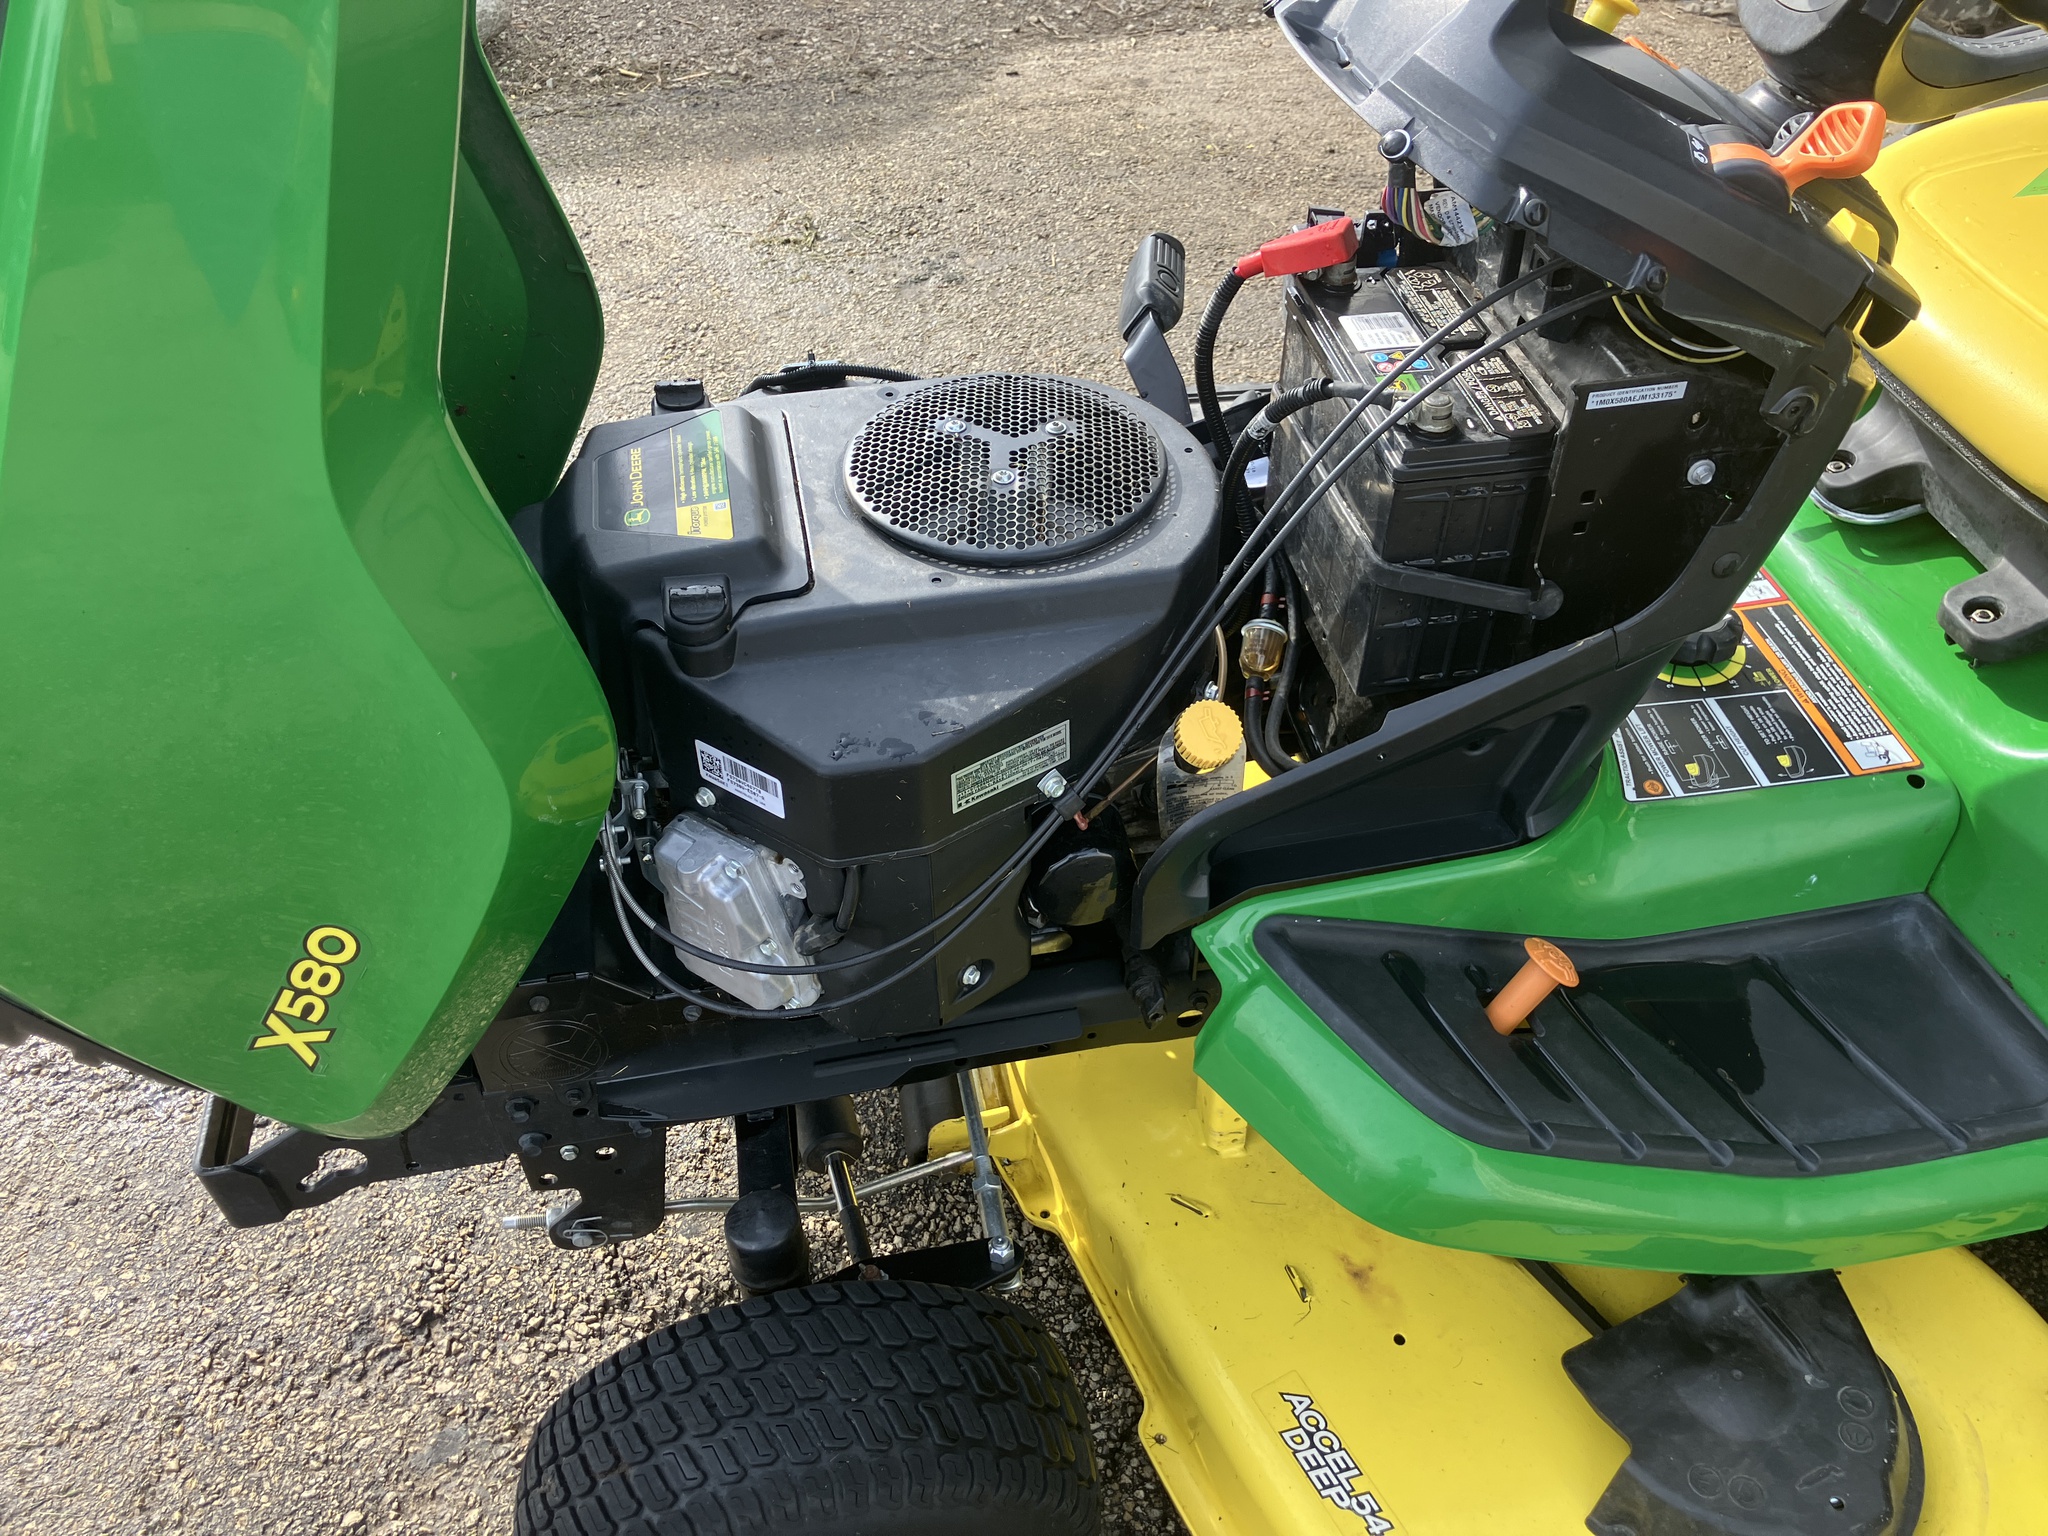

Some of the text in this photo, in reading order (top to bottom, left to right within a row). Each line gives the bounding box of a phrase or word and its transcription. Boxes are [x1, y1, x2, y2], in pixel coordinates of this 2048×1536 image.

[1616, 387, 1656, 396] IDENTIFICATION
[629, 447, 645, 506] JOHN DEERE
[1728, 680, 1740, 689] 1.5
[1765, 668, 1783, 686] LOWER
[1778, 668, 1805, 700] WARNING
[1751, 720, 1761, 729] CUT
[1757, 730, 1767, 738] SET
[1616, 741, 1625, 759] ASSIST
[1635, 724, 1672, 777] POWER MOWER LIFT
[1700, 735, 1716, 752] LOWER
[1725, 726, 1750, 756] CUT HEIGHT
[1621, 760, 1632, 786] TRACTION
[972, 784, 999, 802] Kawasaki
[247, 925, 361, 1073] X580
[1278, 1392, 1395, 1536] ACCEL 54
[1278, 1427, 1353, 1511] DEEP
